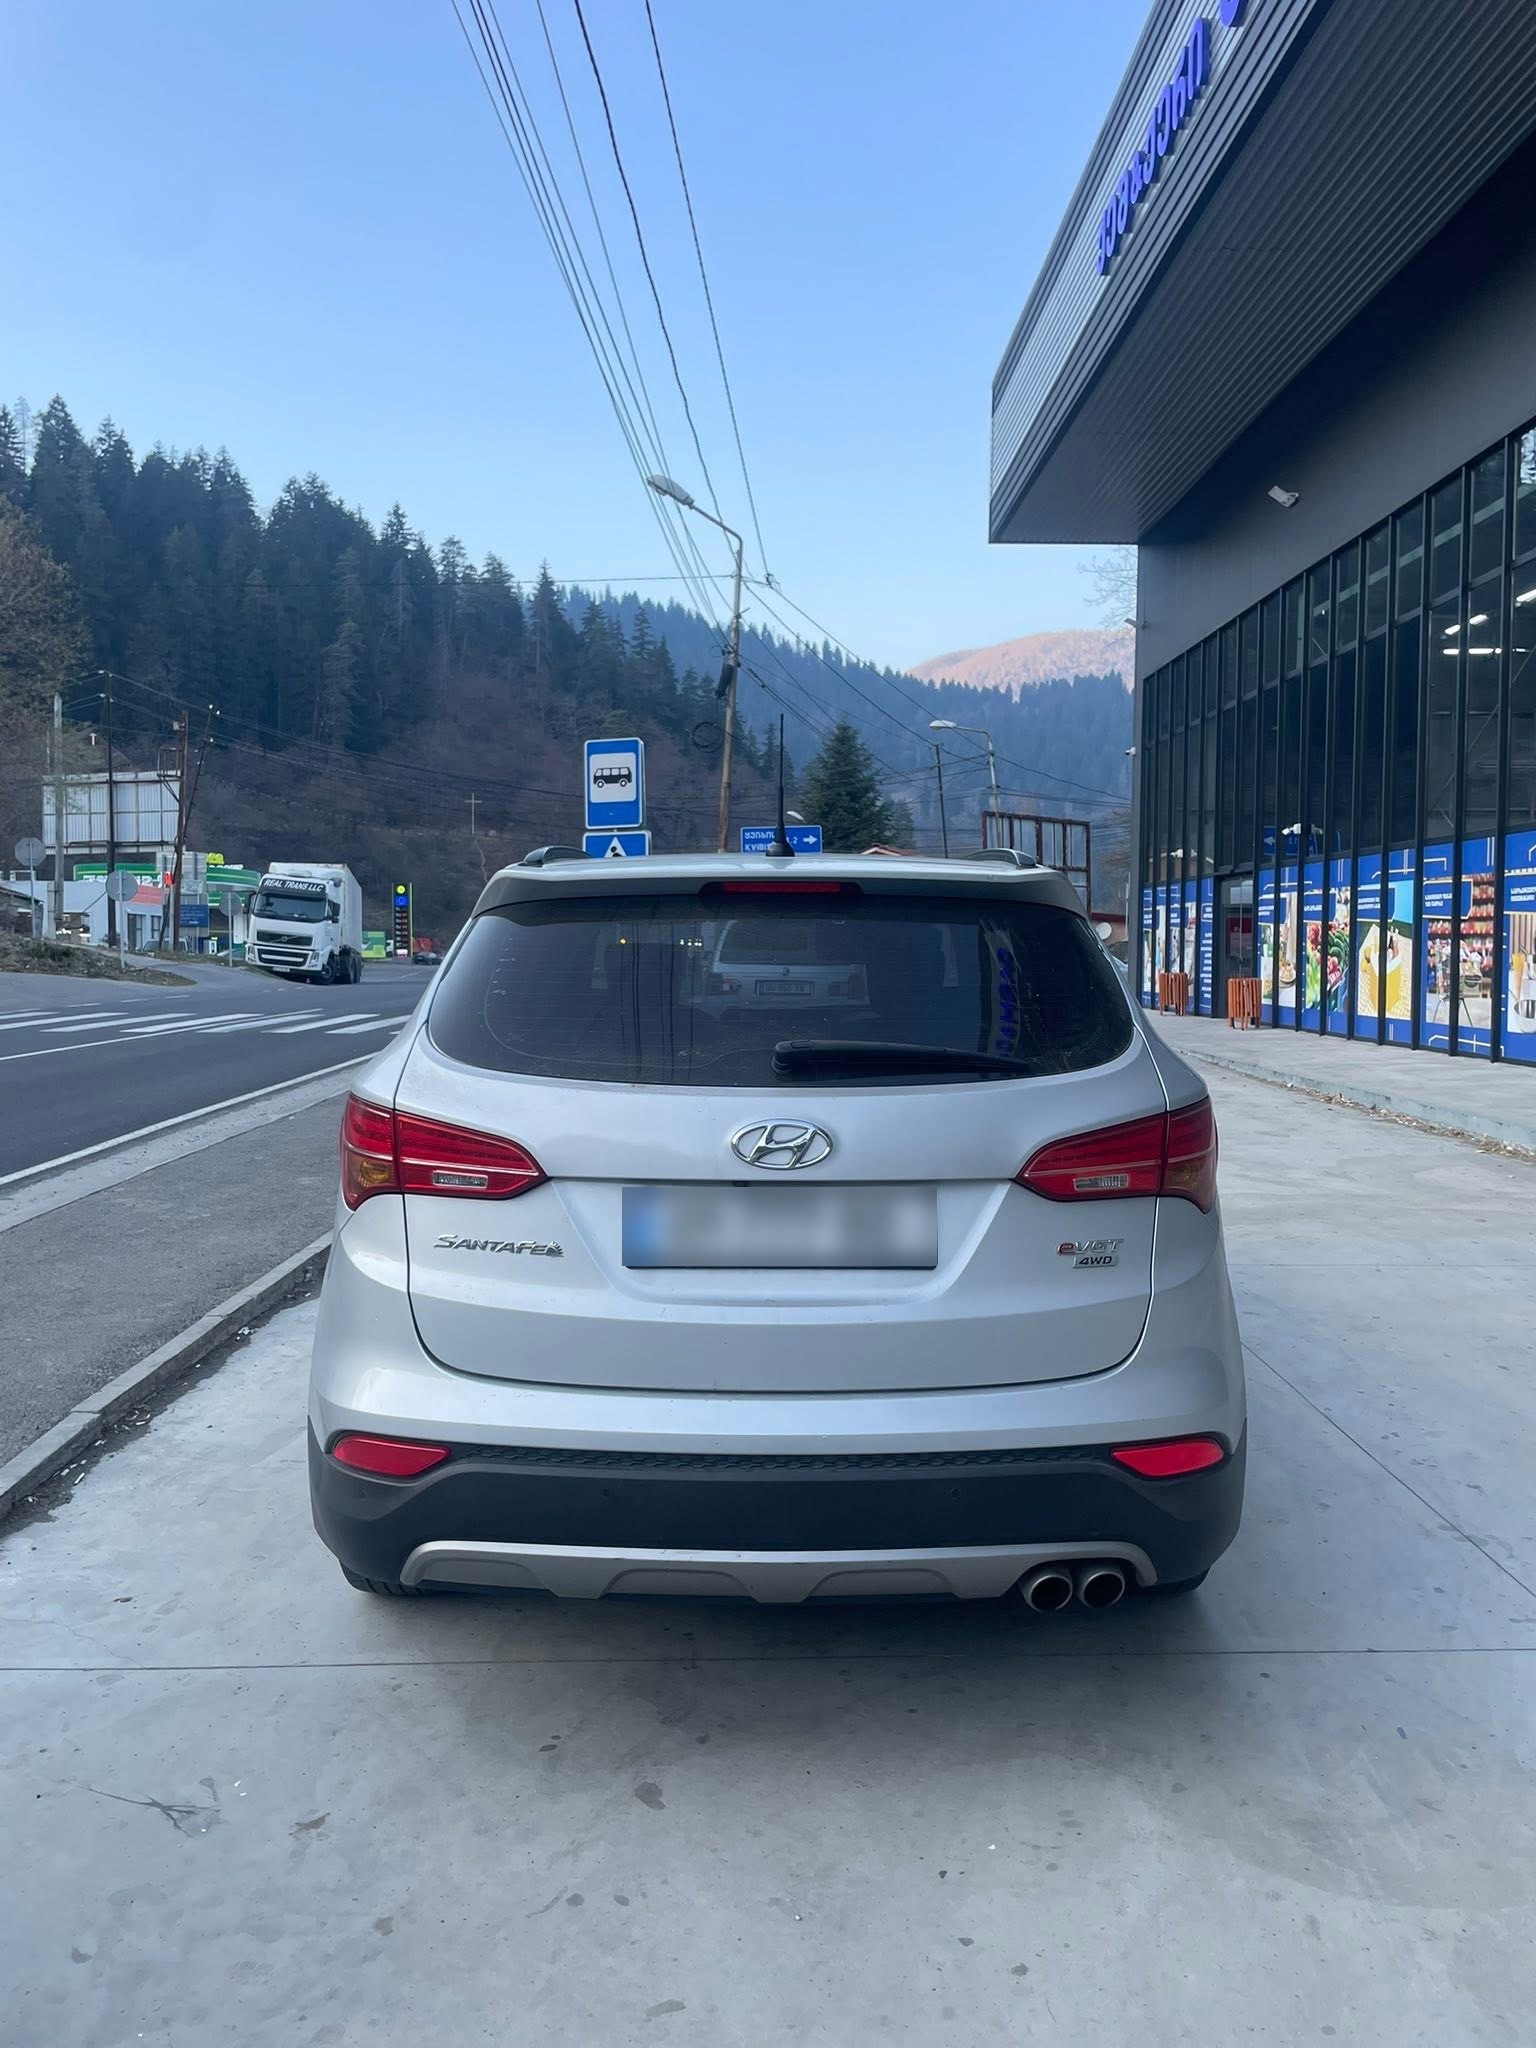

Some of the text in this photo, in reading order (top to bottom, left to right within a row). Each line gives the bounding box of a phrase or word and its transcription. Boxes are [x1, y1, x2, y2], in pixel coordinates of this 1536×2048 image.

[264, 879, 324, 892] REAL TRANS LLC
[1079, 1255, 1113, 1266] 4WD
